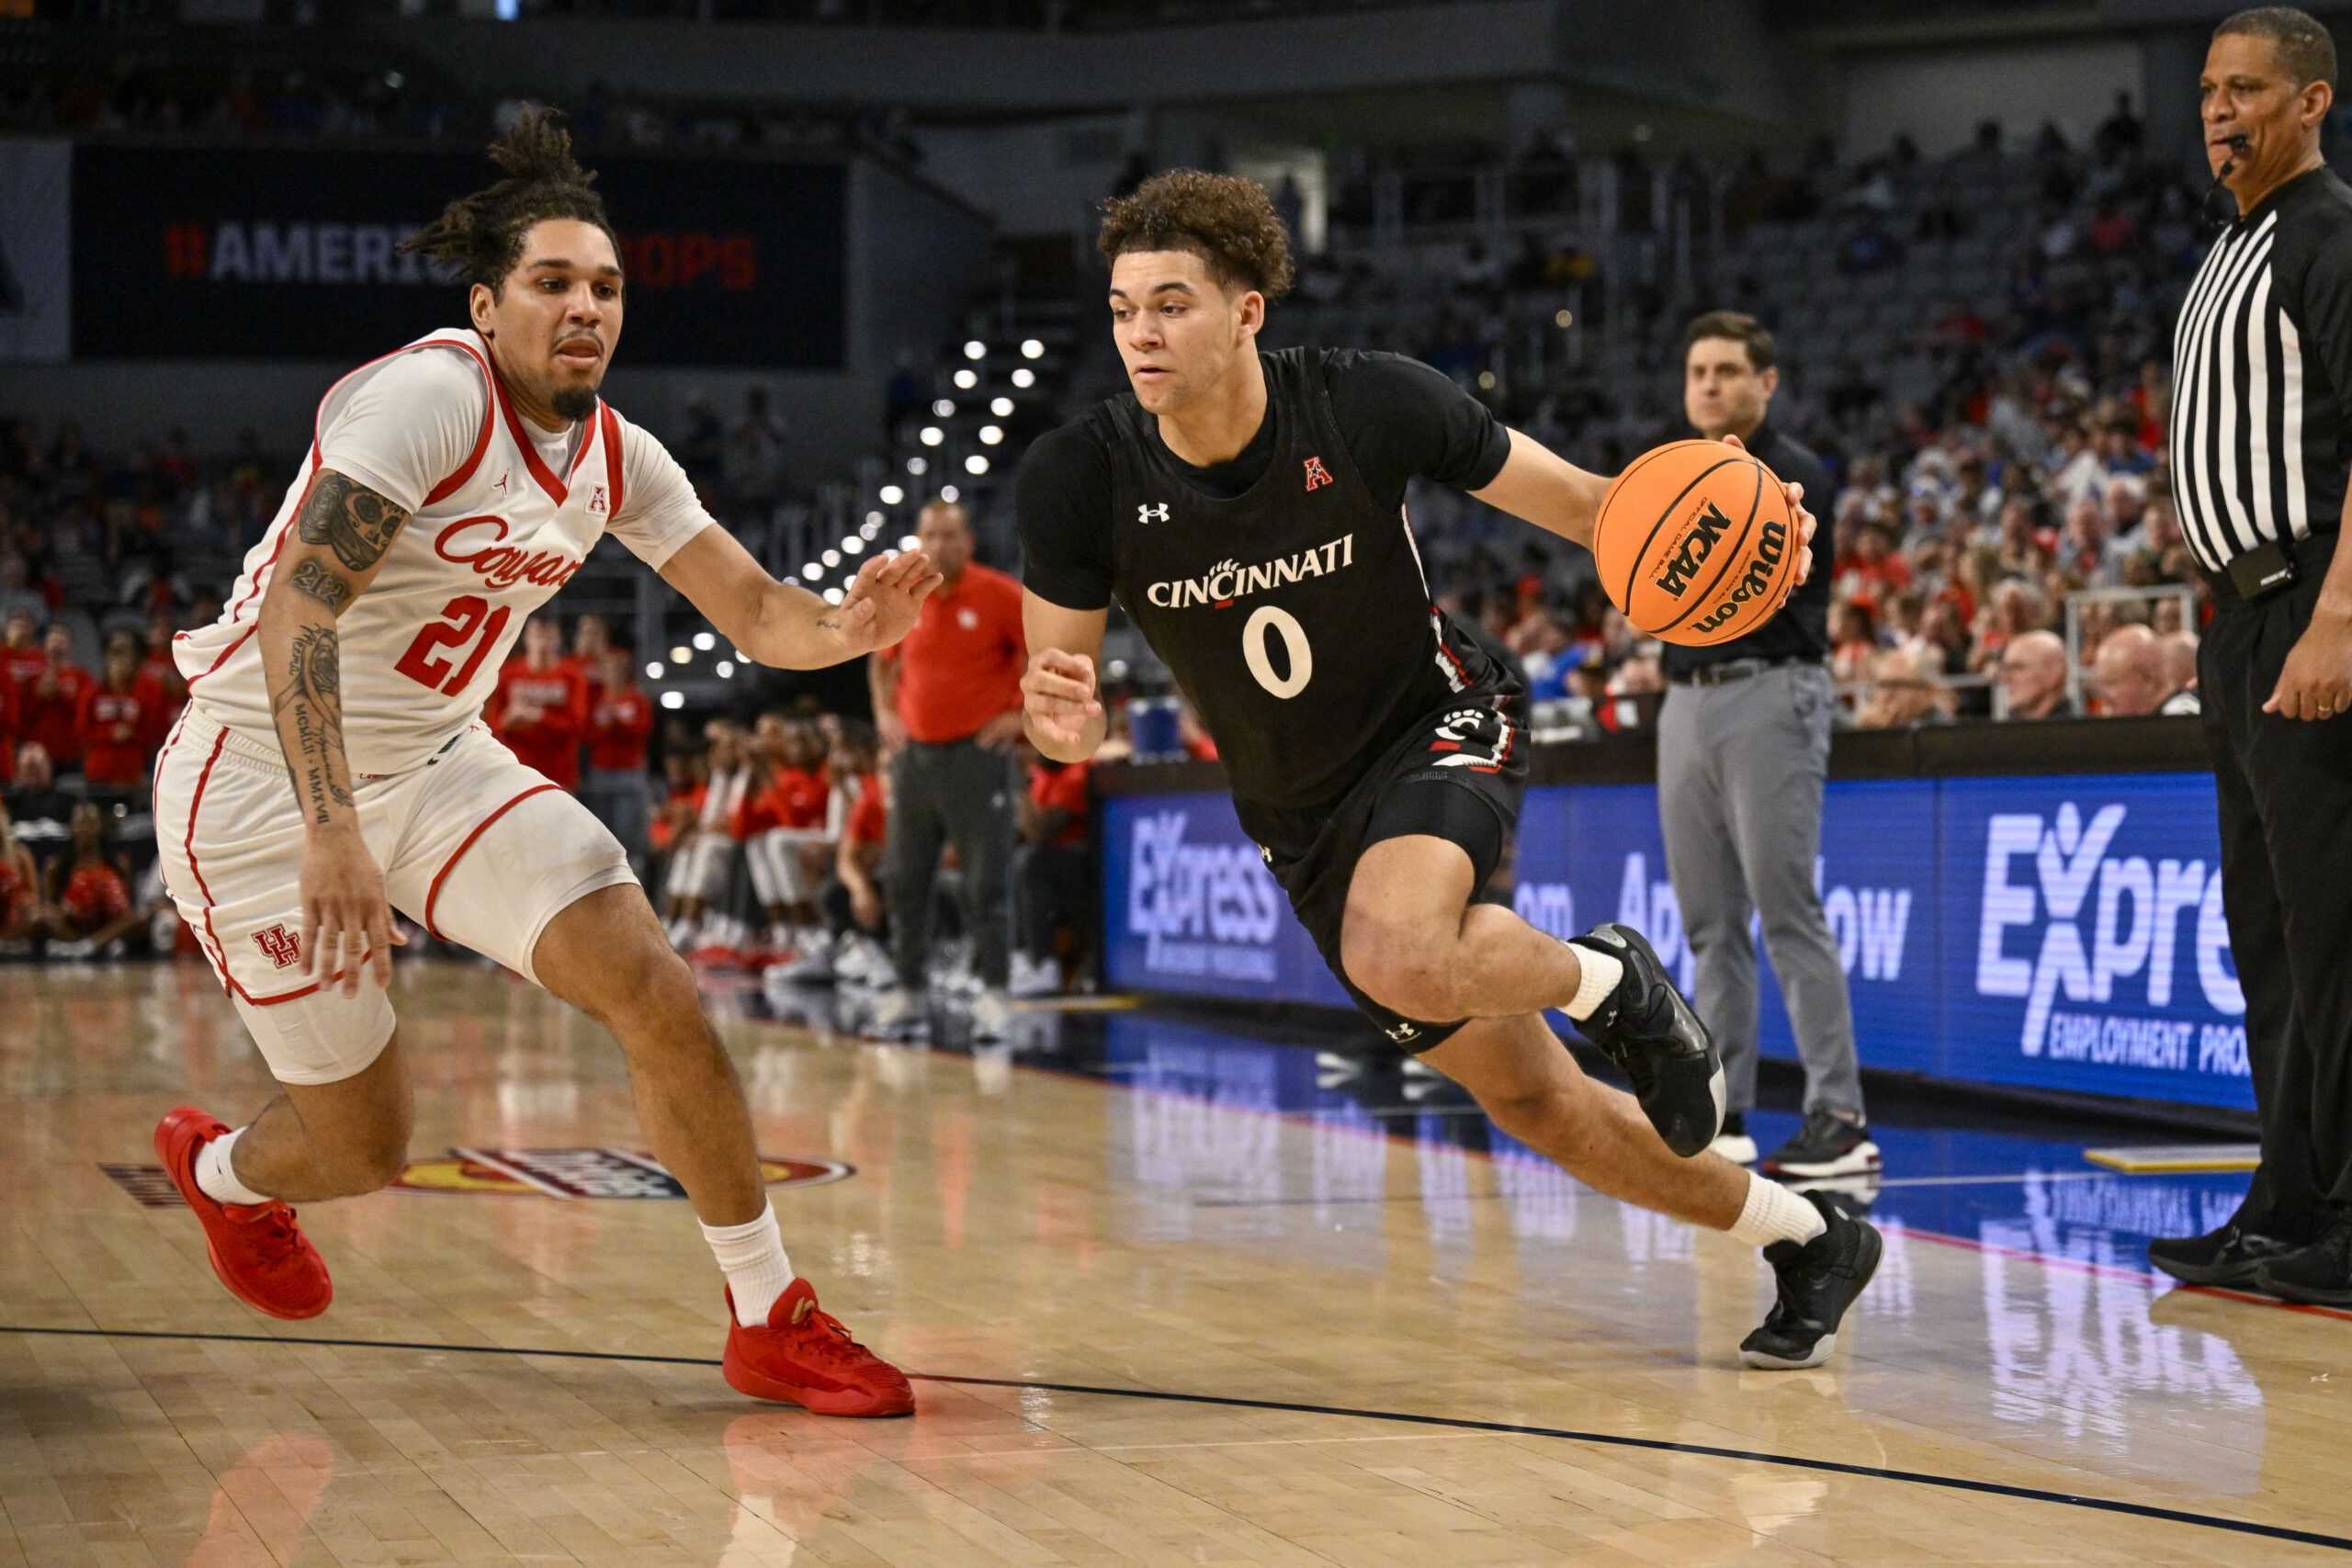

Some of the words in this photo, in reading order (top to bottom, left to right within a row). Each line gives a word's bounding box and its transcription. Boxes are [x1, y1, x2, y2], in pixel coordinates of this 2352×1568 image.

[1148, 534, 1353, 608] CINCINNATI
[1657, 502, 1732, 598] NCAA
[1690, 520, 1786, 633] Wilson
[393, 595, 512, 696] 21
[1243, 605, 1312, 699] 0
[1815, 855, 1912, 982] ow
[2049, 1011, 2194, 1072] EMPLOYMENT
